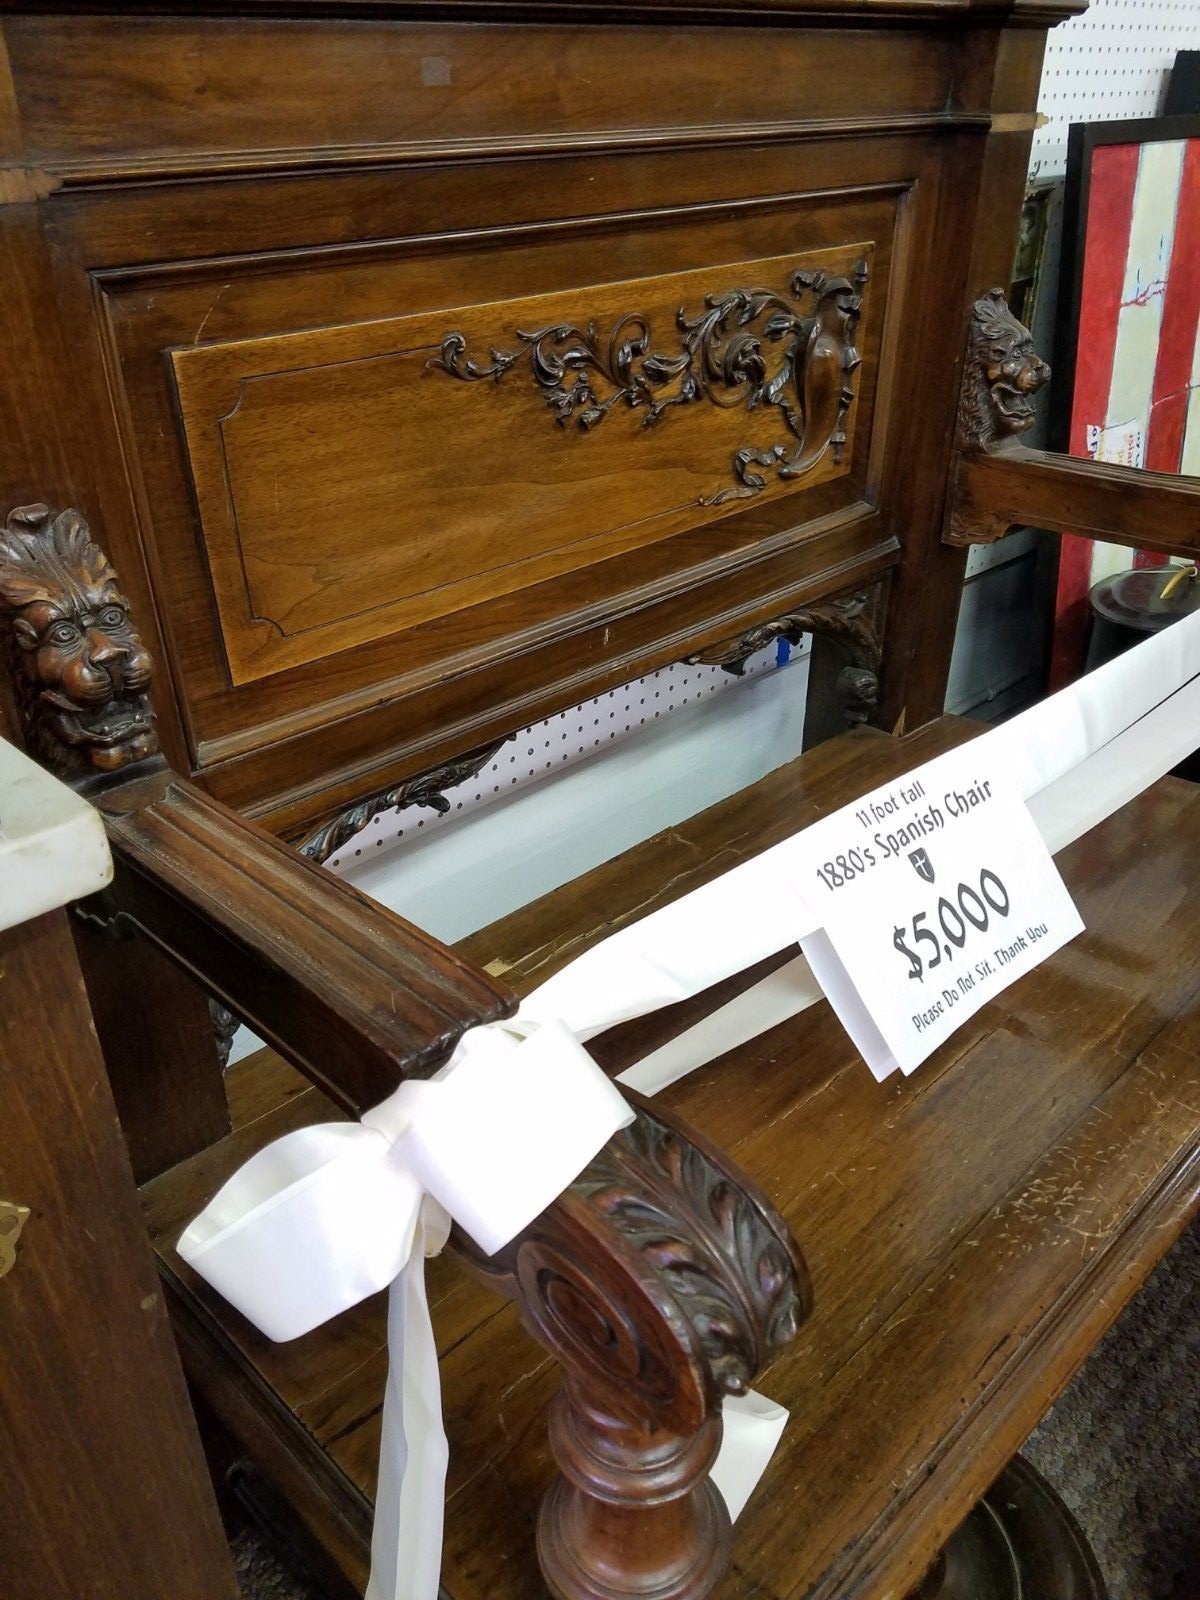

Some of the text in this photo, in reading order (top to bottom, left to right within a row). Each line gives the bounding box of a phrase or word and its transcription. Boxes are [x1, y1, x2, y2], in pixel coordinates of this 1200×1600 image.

[816, 779, 992, 892] 1880's Spanish Chair
[855, 780, 926, 828] 11 foot tall
[893, 868, 1010, 984] $5,000
[911, 1000, 944, 1034] Please
[941, 989, 960, 1008] Do
[993, 935, 1029, 967] Thank
[1025, 923, 1049, 941] You
